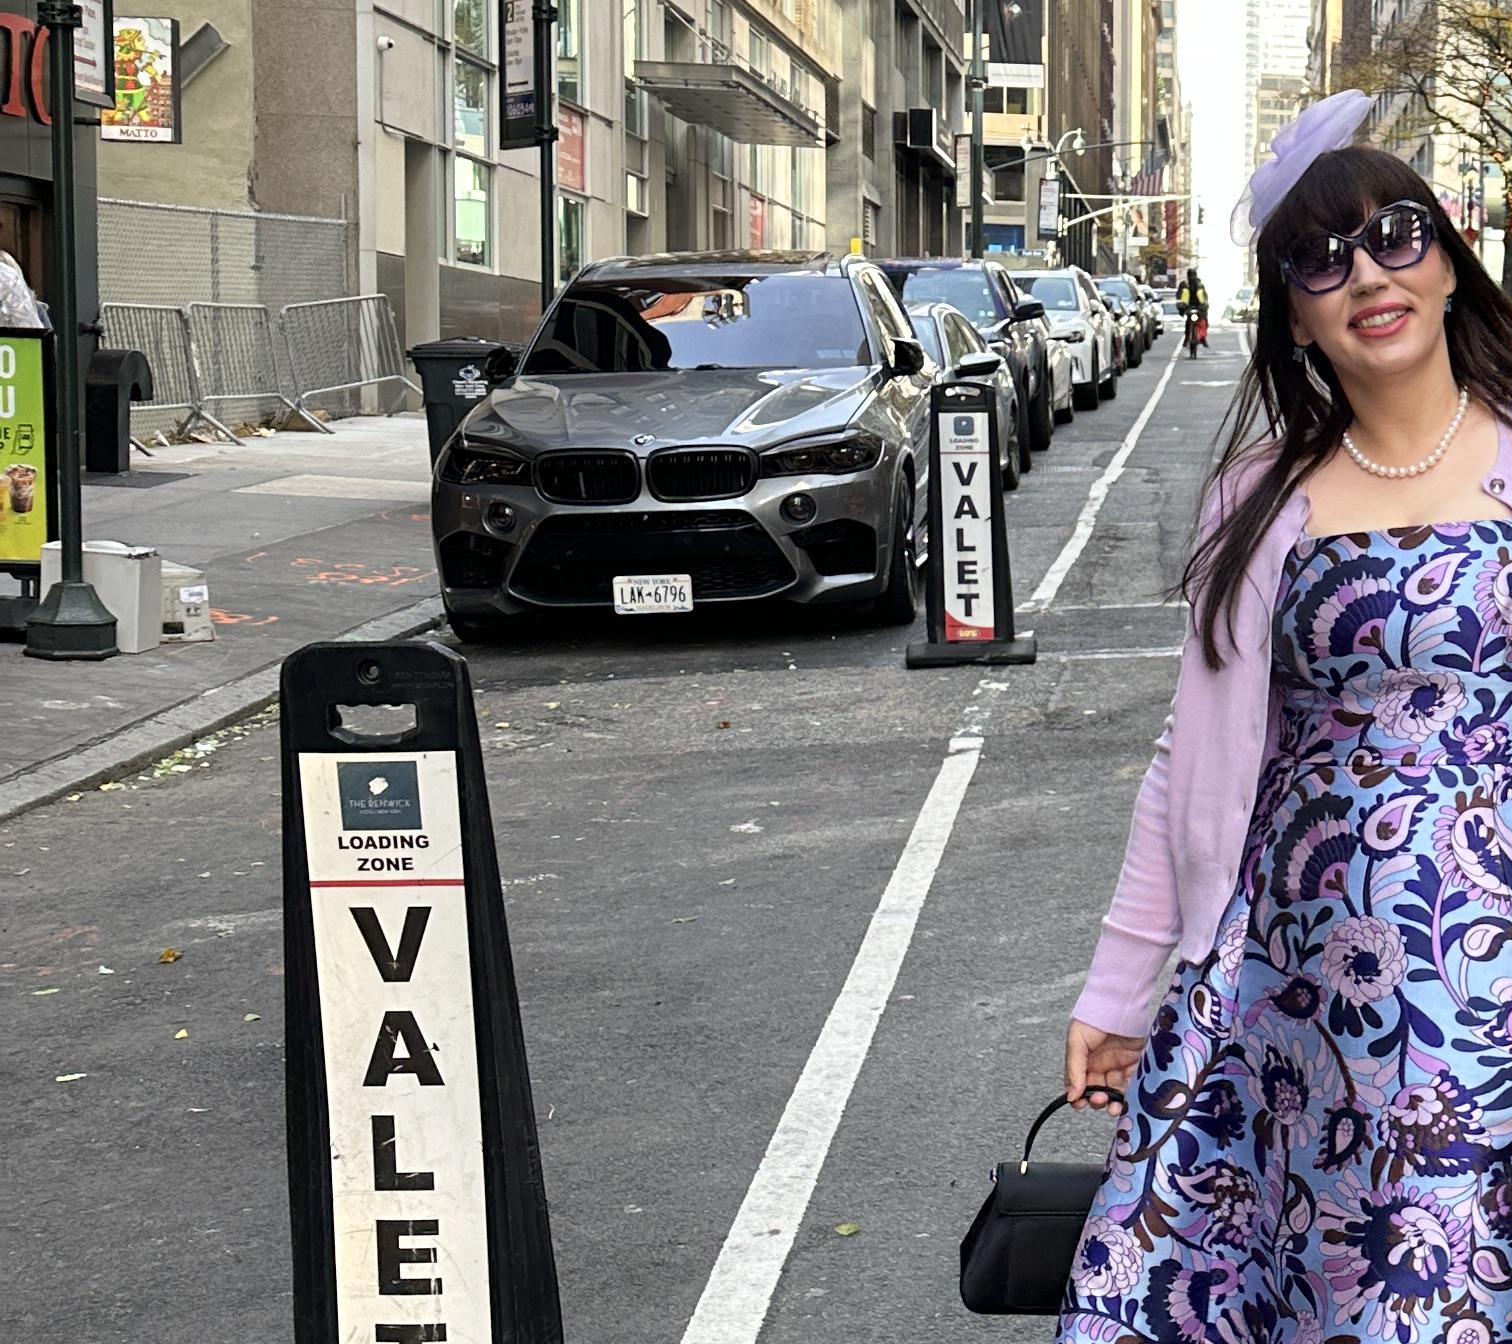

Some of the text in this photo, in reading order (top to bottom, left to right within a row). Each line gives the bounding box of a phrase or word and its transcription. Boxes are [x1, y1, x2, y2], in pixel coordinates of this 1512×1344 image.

[507, 3, 513, 22] 2
[119, 129, 158, 138] MATTO
[952, 462, 980, 617] VALET
[338, 835, 429, 850] LOADING
[357, 857, 414, 871] ZONE
